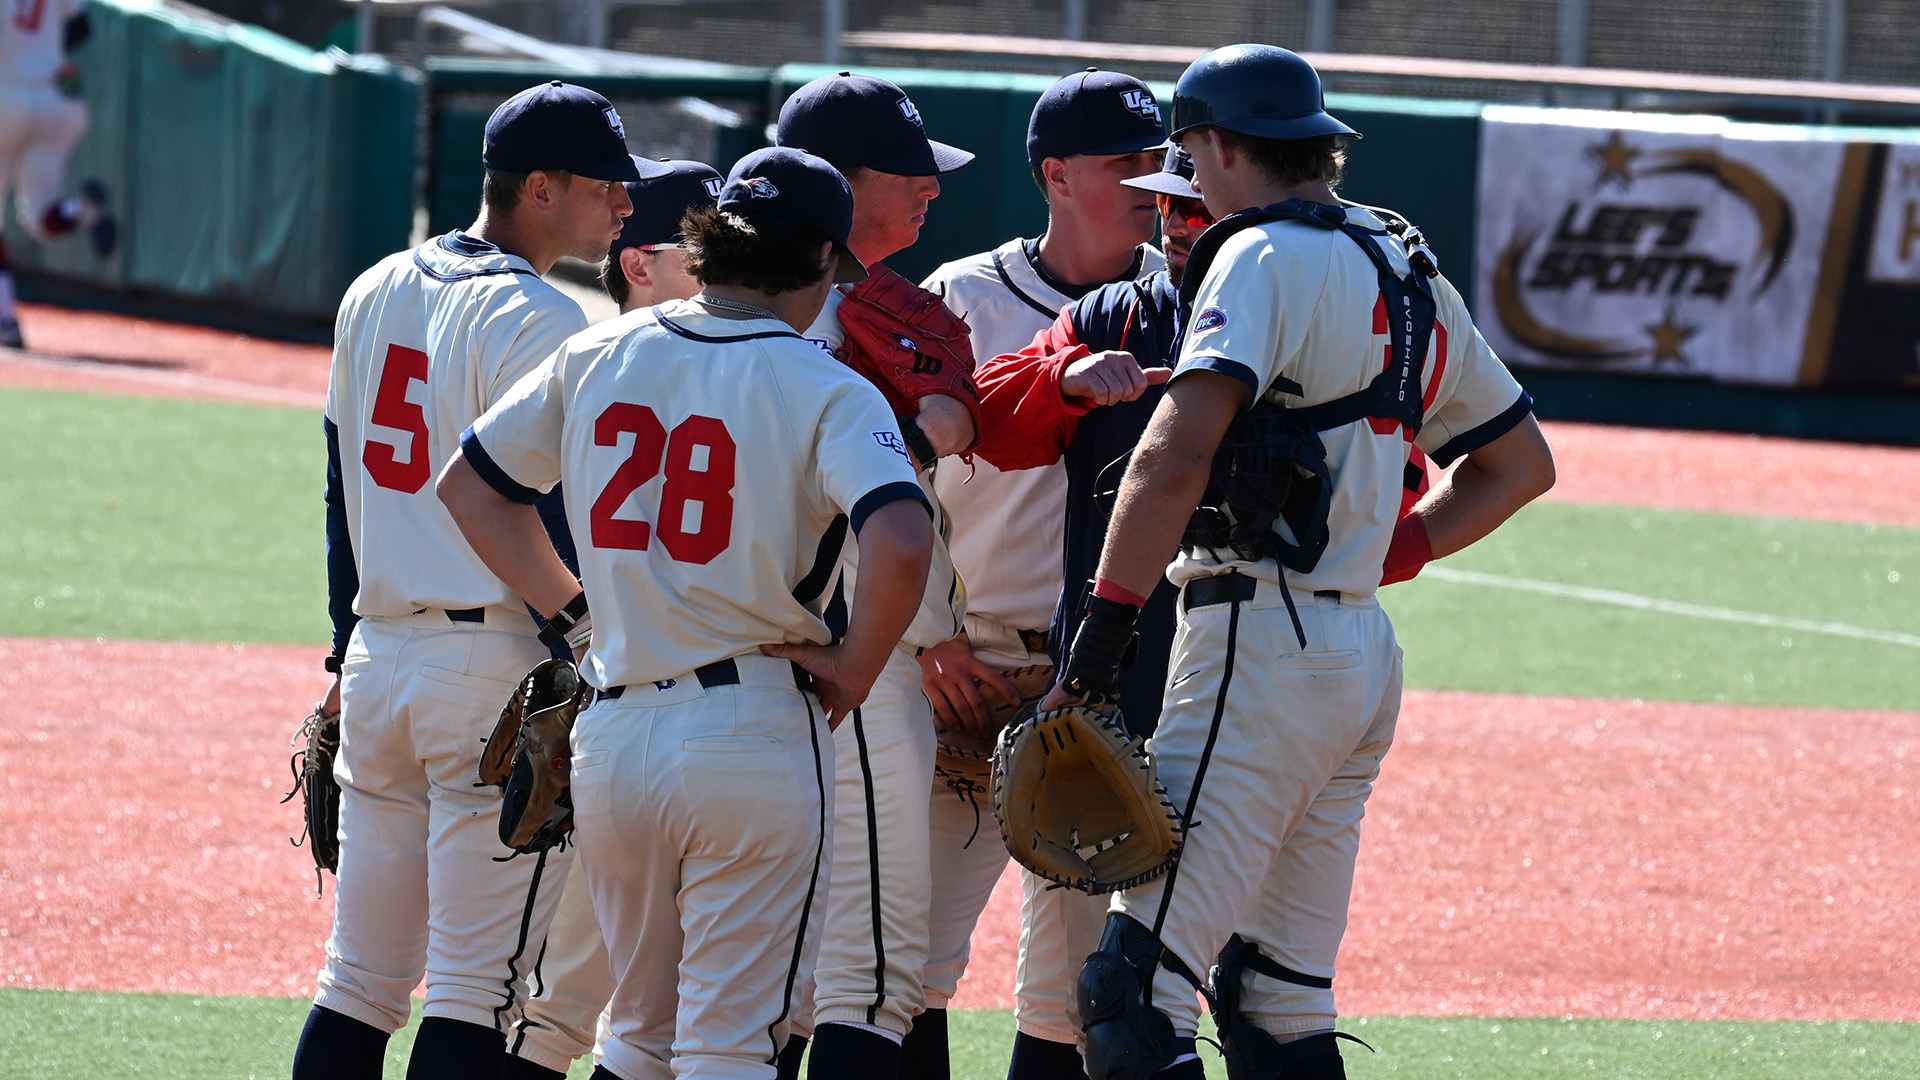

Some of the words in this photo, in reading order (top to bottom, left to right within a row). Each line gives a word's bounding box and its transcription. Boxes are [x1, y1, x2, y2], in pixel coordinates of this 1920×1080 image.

[1529, 249, 1737, 303] SPORTS
[1553, 201, 1703, 246] LEE'S
[1398, 295, 1414, 402] EVOSHIELD
[362, 343, 431, 494] 5
[590, 402, 737, 565] 28
